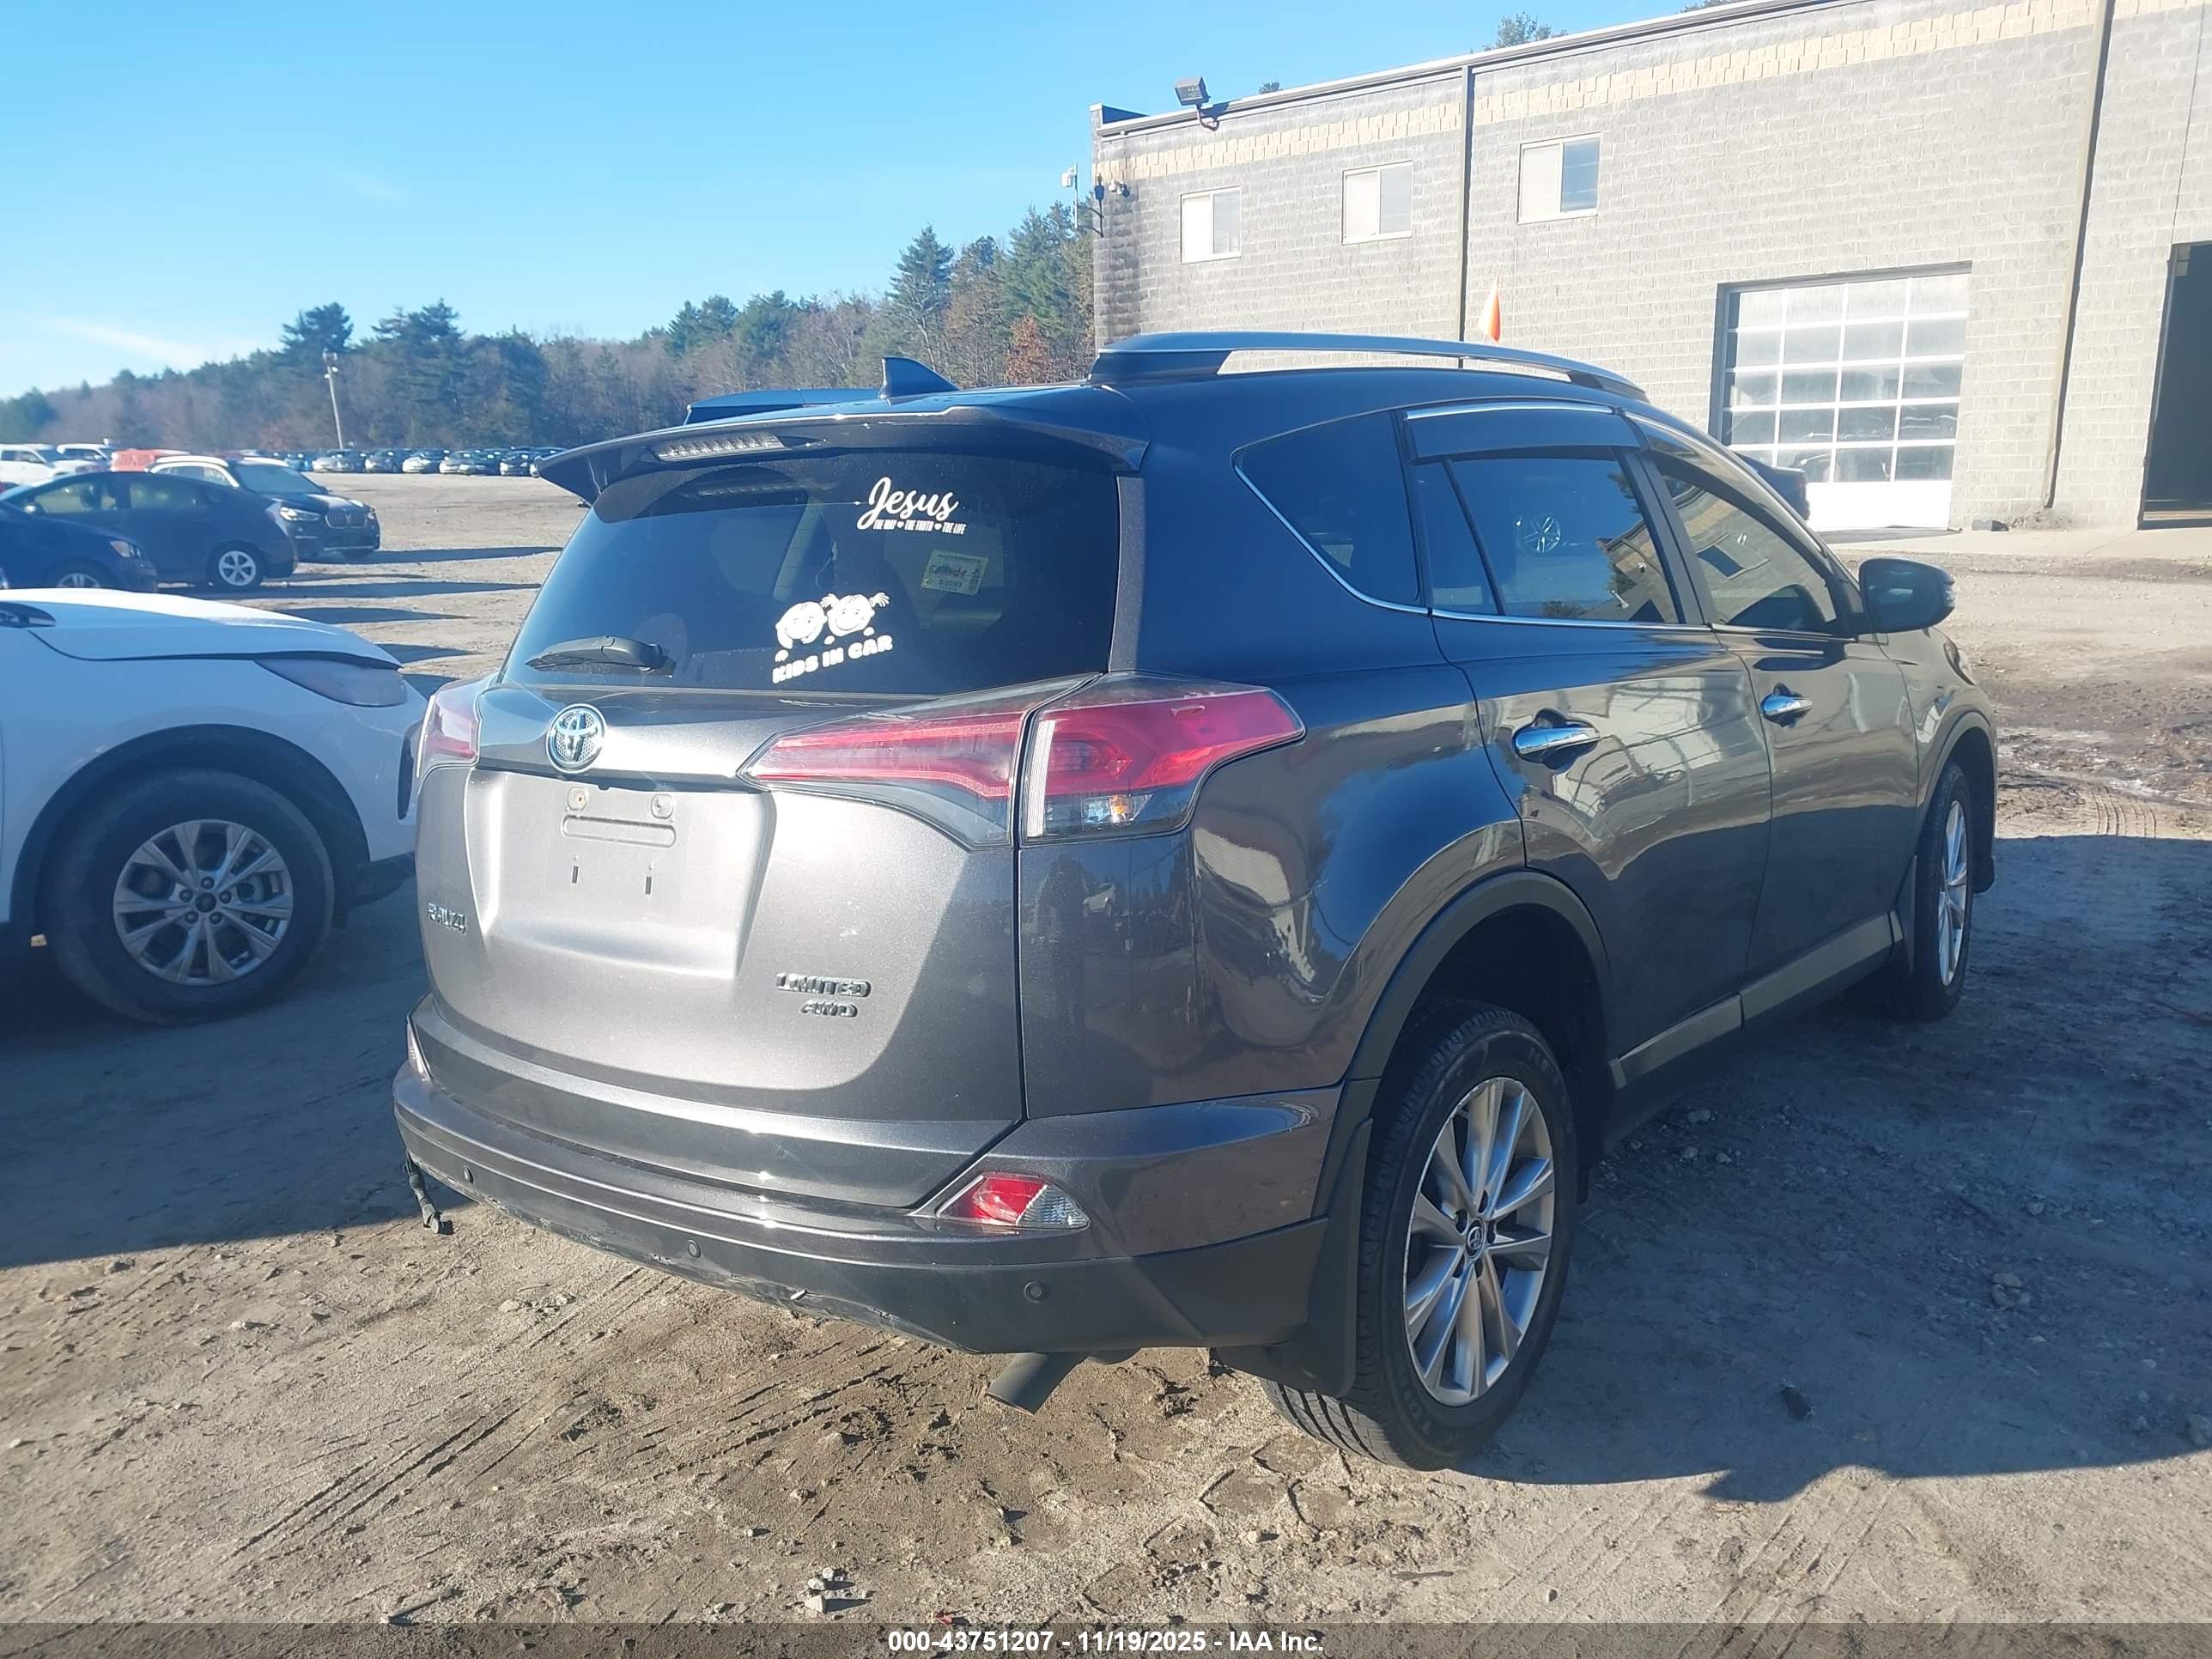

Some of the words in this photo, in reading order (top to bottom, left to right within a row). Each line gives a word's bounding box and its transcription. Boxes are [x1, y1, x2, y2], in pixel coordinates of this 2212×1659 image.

[857, 477, 959, 530] Jesus
[772, 655, 819, 684] KIDS
[822, 647, 844, 667] IN
[848, 635, 894, 659] CAR
[775, 972, 872, 998] LIMITED
[799, 1000, 858, 1018] AWD
